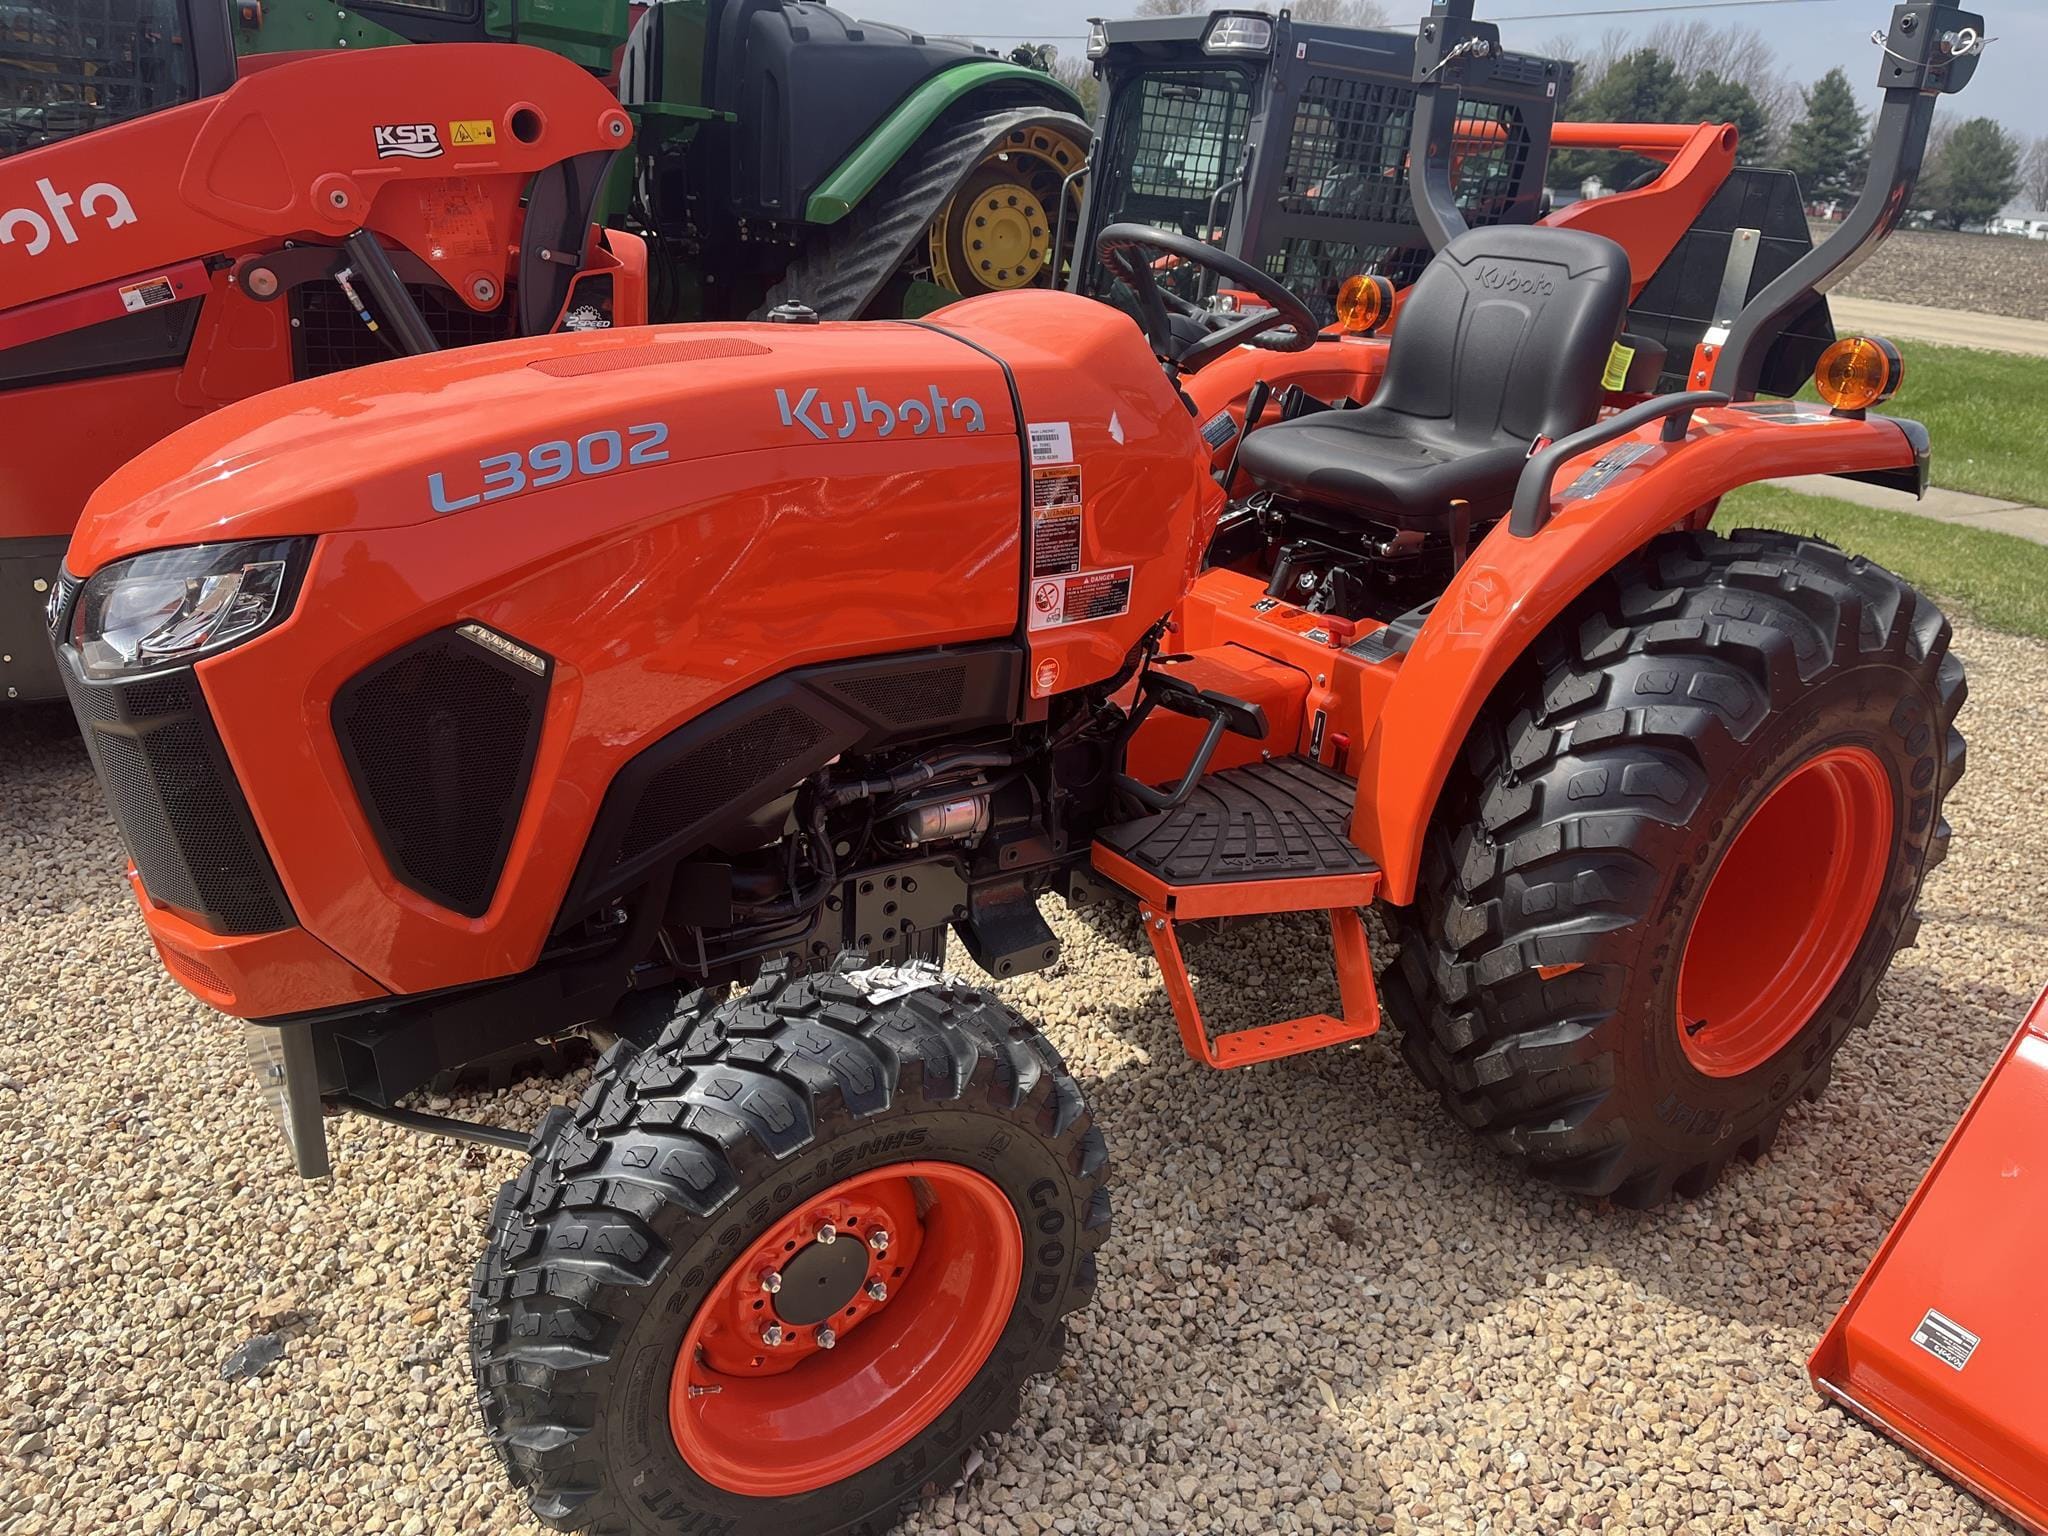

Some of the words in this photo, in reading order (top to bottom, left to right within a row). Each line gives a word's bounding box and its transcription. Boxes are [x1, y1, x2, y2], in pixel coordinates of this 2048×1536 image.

[375, 124, 438, 145] KSR
[1474, 265, 1556, 297] Kubota
[775, 384, 987, 440] Kubota
[428, 421, 671, 514] L3902
[1090, 573, 1115, 584] DANGER
